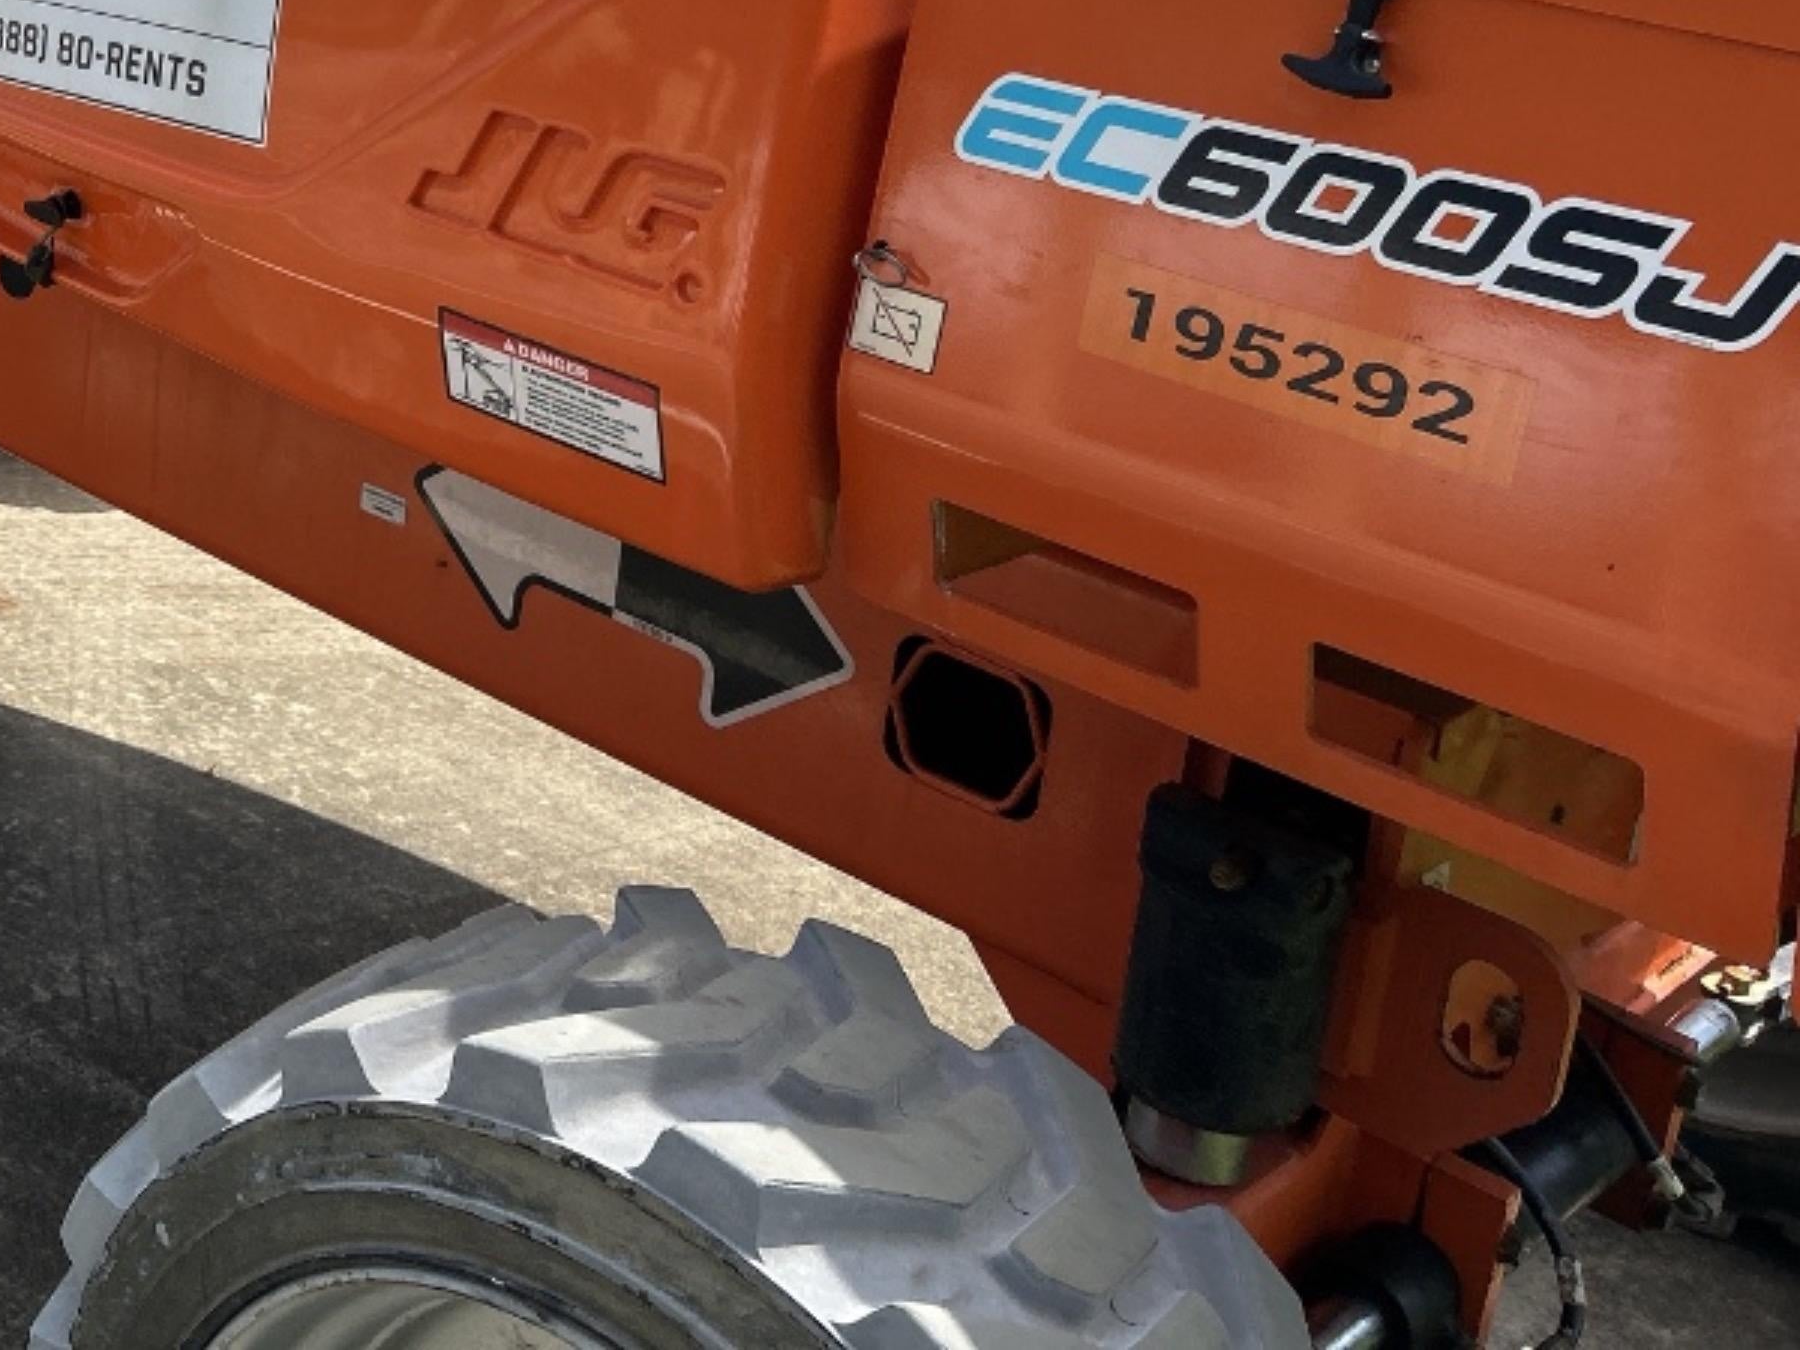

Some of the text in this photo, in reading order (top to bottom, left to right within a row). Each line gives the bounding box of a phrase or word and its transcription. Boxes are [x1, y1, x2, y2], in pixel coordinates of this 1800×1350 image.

[57, 30, 208, 97] 80-RENTS
[406, 109, 727, 293] JLG
[956, 74, 1800, 349] EC600SJ
[518, 342, 590, 383] DANGER
[1125, 287, 1475, 445] 195292
